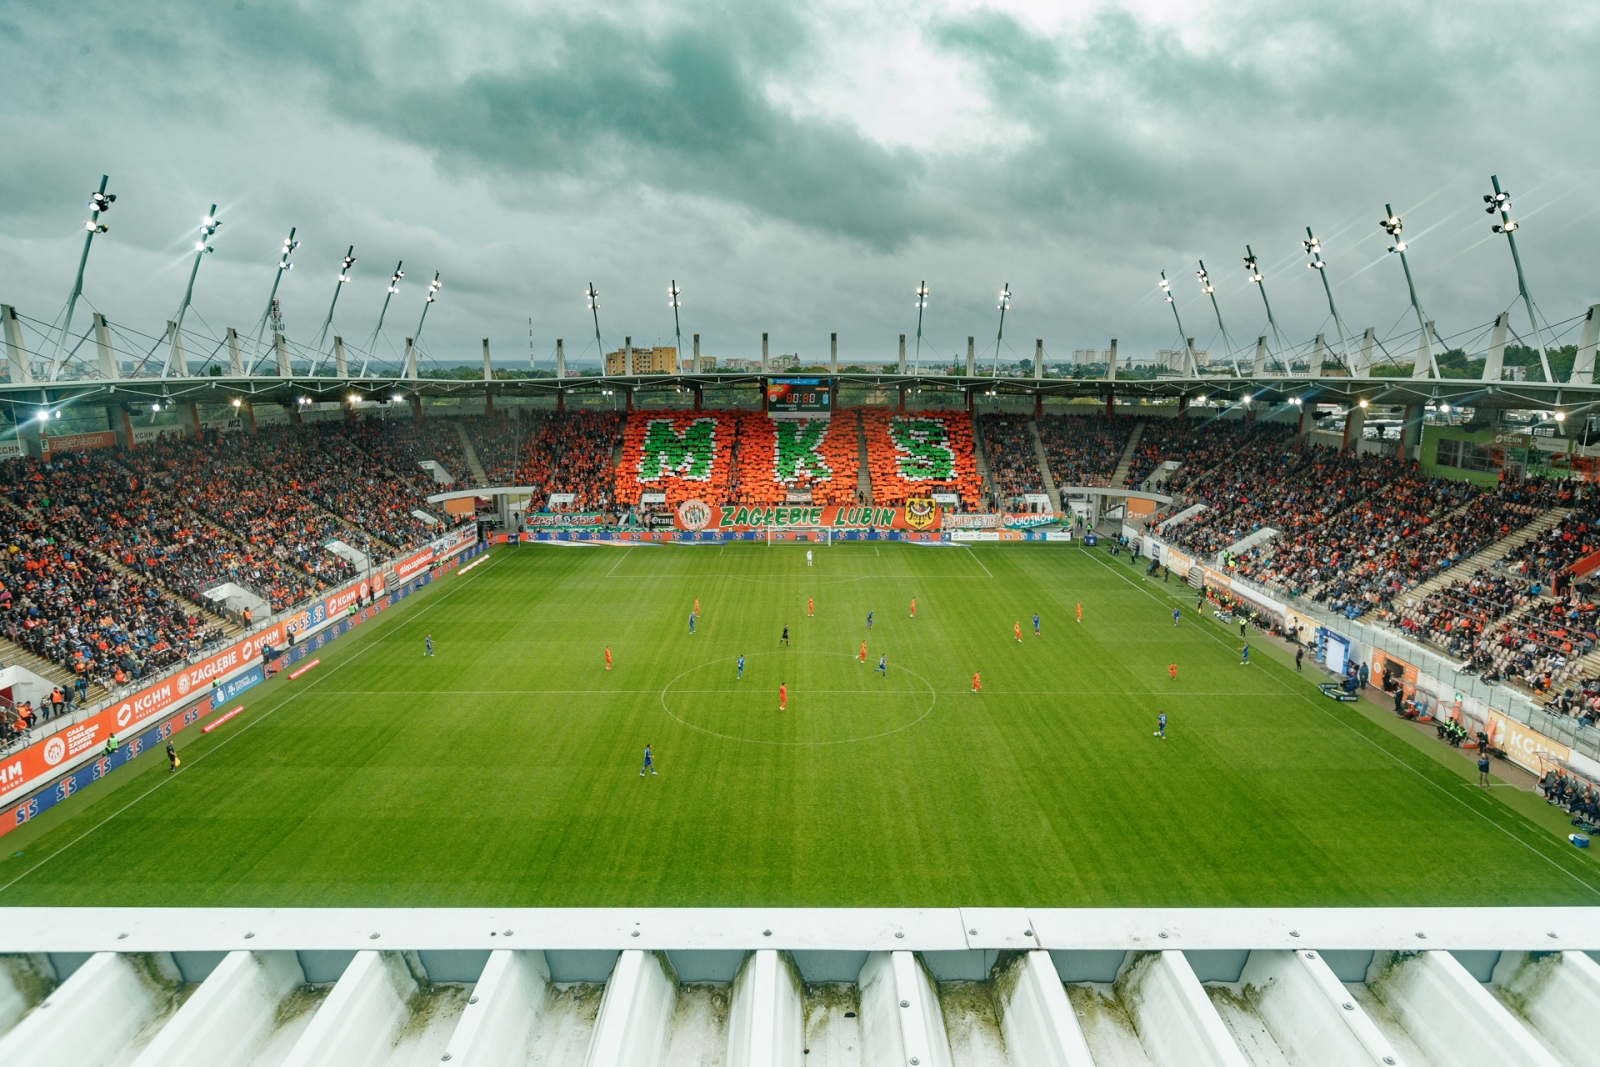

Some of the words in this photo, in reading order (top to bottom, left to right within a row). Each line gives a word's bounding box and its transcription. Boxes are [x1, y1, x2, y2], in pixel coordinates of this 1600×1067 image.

[134, 432, 154, 440] KGHM
[1504, 436, 1522, 444] KGHM
[652, 516, 674, 526] Orang
[834, 507, 896, 527] LUBIN
[337, 590, 356, 606] KGHM
[286, 619, 298, 634] STS
[300, 612, 311, 630] STS
[313, 605, 324, 622] STS
[254, 629, 279, 650] KGHM
[281, 654, 290, 670] STS
[299, 643, 308, 658] STS
[190, 652, 237, 685] ZAGŁĘBIE
[134, 684, 171, 714] KGHM
[15, 798, 38, 826] STS
[56, 776, 77, 802] STS
[93, 756, 112, 780] STS
[126, 737, 143, 760] STS
[156, 721, 172, 743] STS
[184, 707, 198, 726] STS
